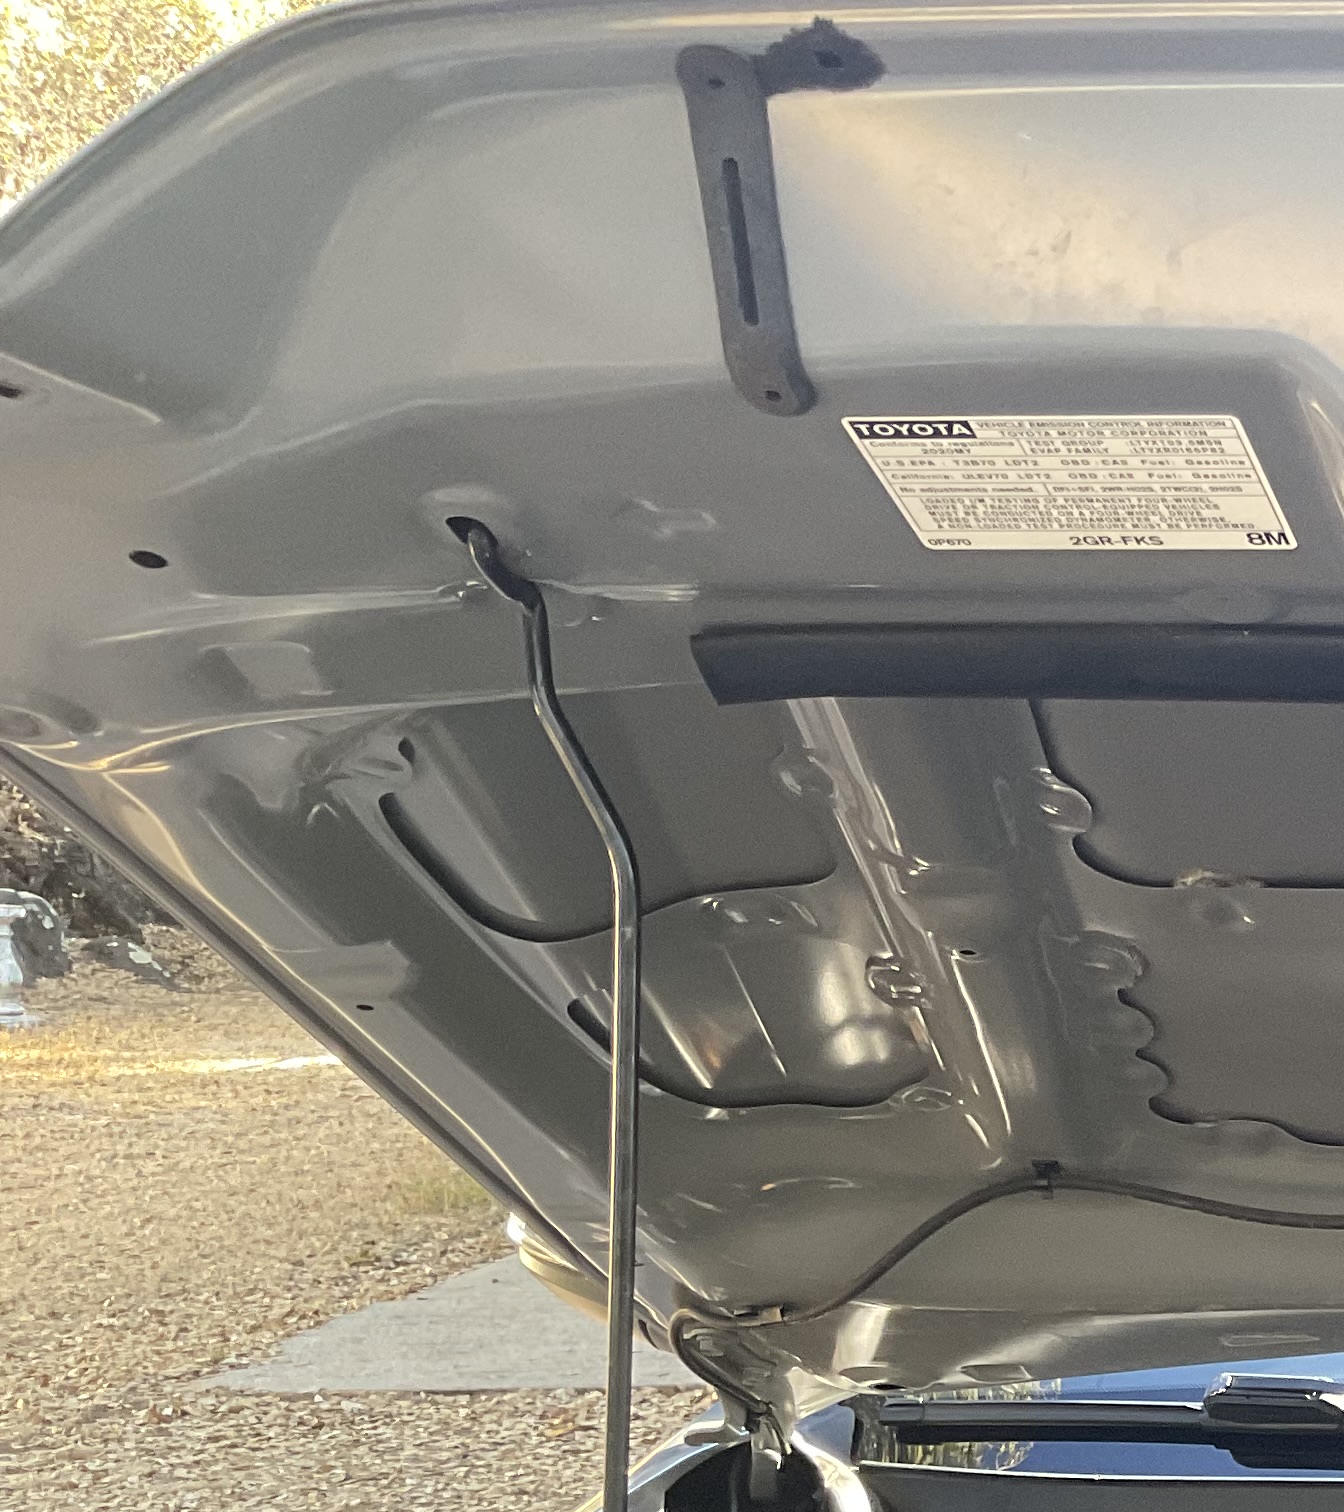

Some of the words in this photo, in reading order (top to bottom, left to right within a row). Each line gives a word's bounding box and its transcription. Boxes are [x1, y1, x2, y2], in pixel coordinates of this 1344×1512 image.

[853, 423, 973, 436] TOYOTA
[869, 440, 927, 448] Conforms
[947, 440, 1015, 448] regulations
[919, 486, 989, 494] adjustments
[1069, 535, 1164, 546] 2GR-FKS
[1246, 532, 1291, 546] 8M
